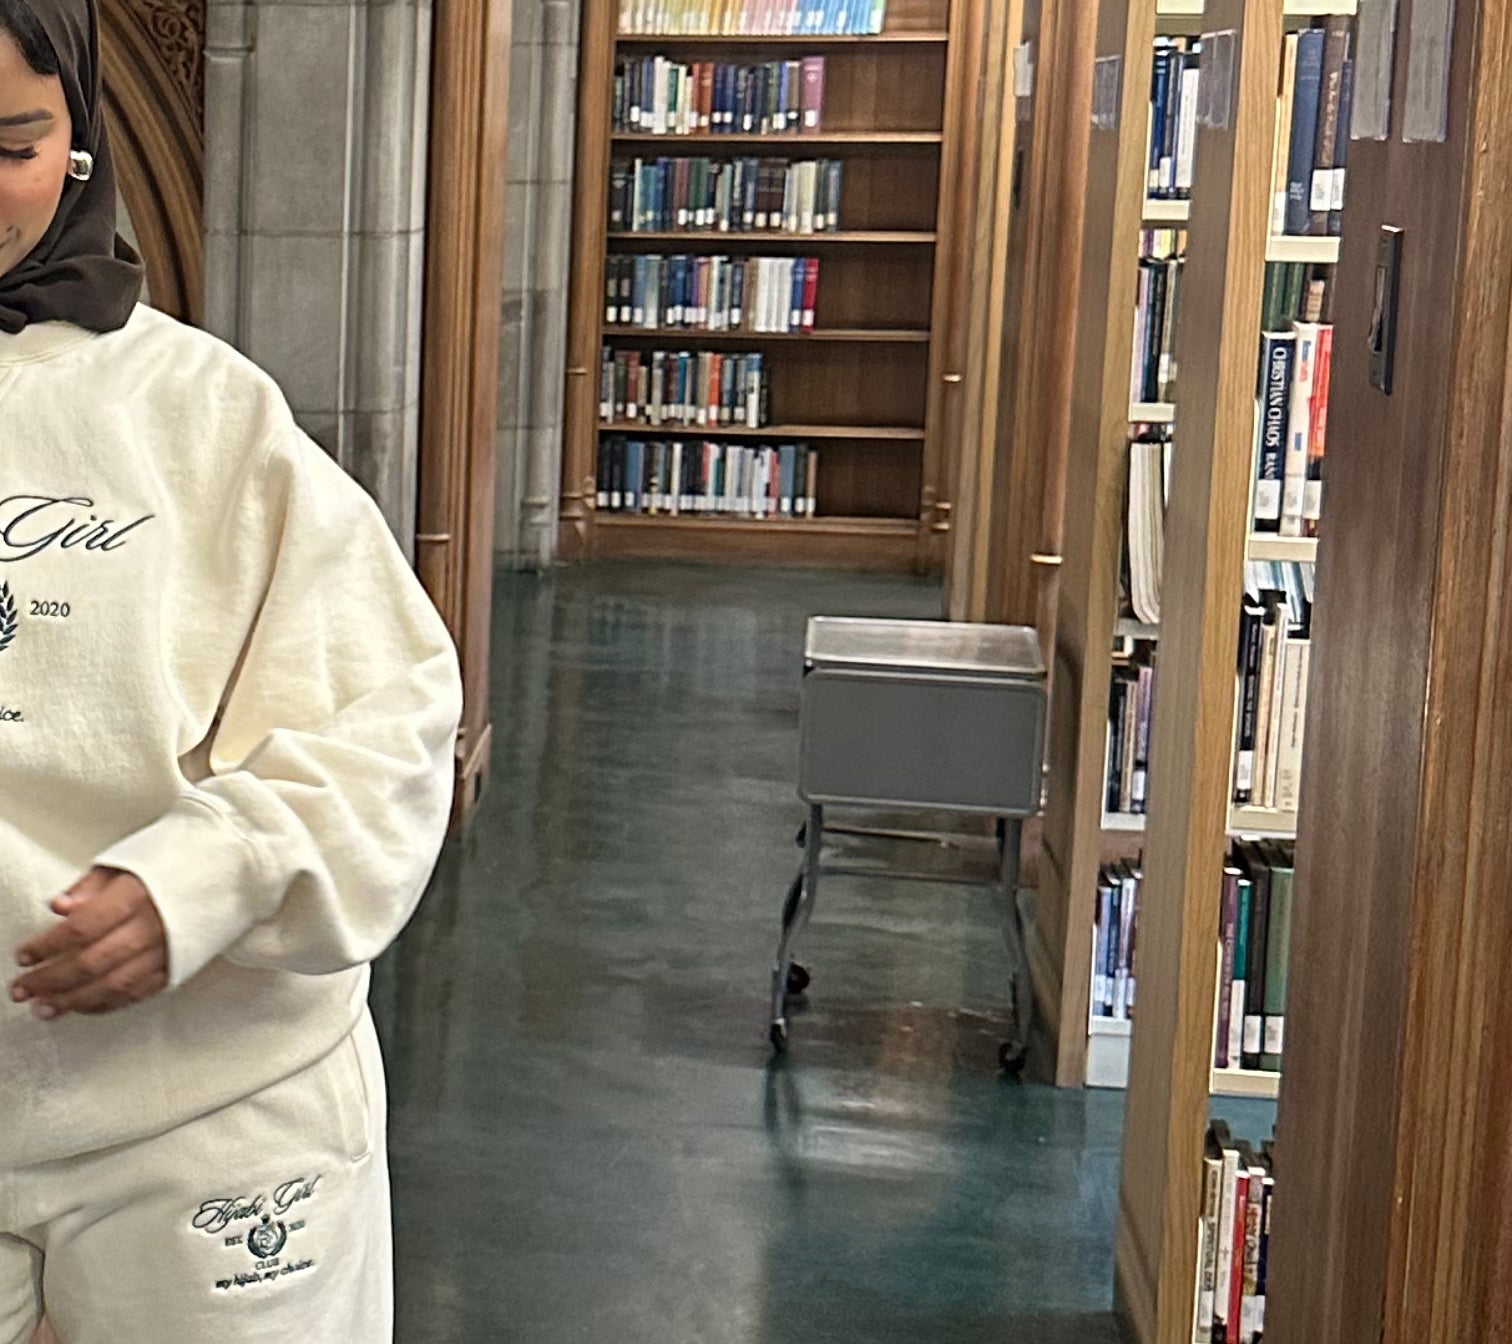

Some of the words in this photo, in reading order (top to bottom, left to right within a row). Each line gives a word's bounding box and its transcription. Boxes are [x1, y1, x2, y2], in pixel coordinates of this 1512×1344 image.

[1270, 346, 1288, 406] CHRISTIAN
[1266, 407, 1281, 447] CHAOS
[29, 600, 71, 618] 2020
